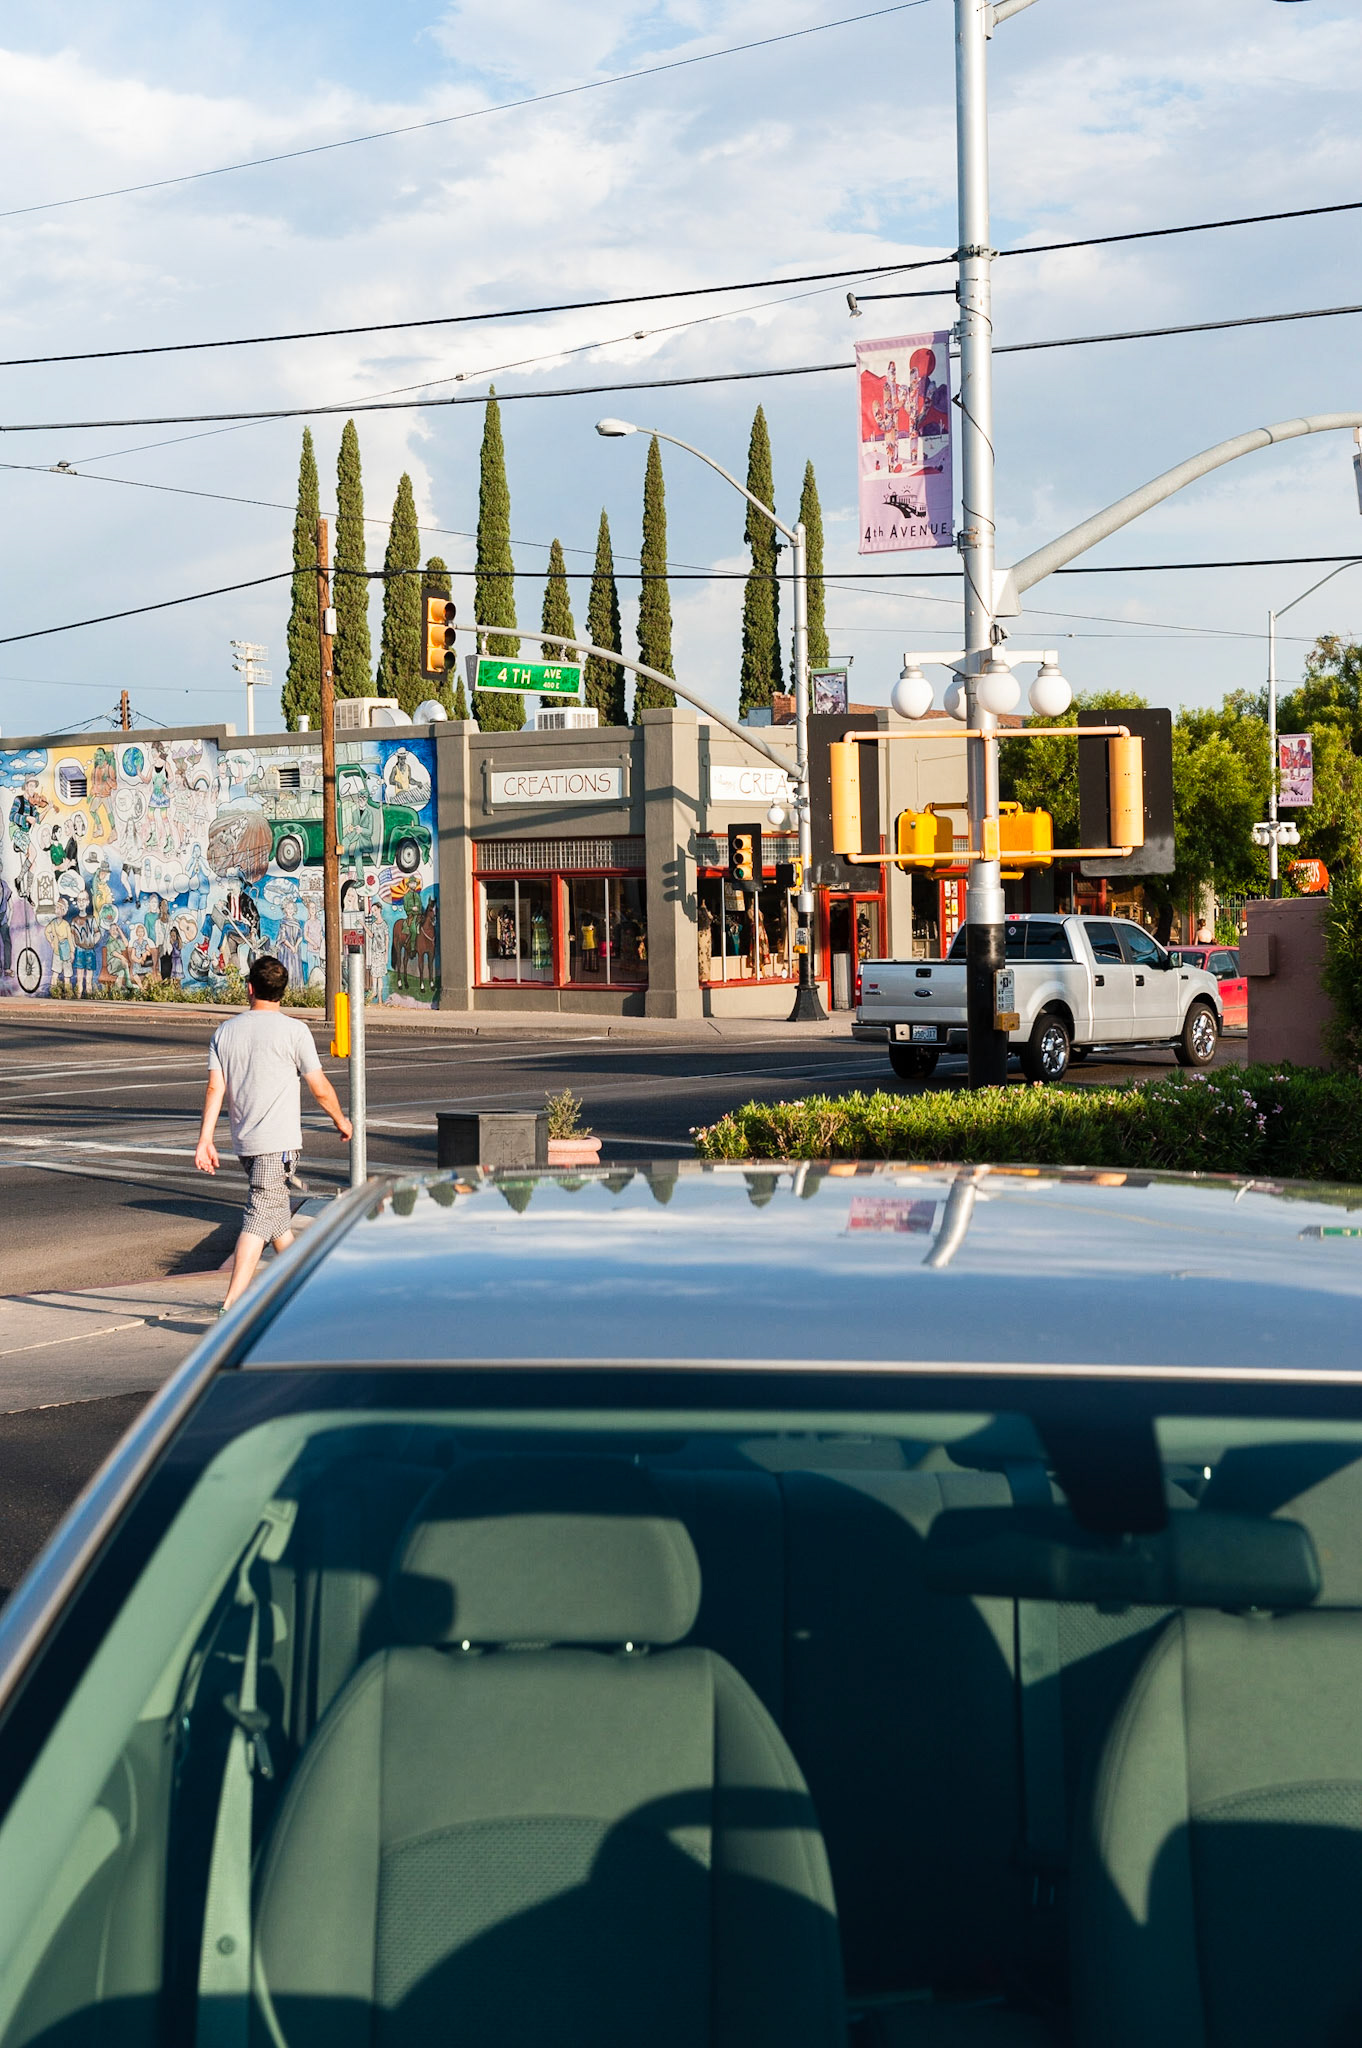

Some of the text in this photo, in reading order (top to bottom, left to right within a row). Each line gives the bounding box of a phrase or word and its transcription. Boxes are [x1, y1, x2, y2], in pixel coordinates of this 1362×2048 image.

[864, 522, 948, 543] 4th AVENUE
[497, 667, 562, 685] 4TH AVE
[542, 681, 555, 689] 400
[503, 772, 611, 797] CREATIONS
[738, 772, 796, 796] CREA
